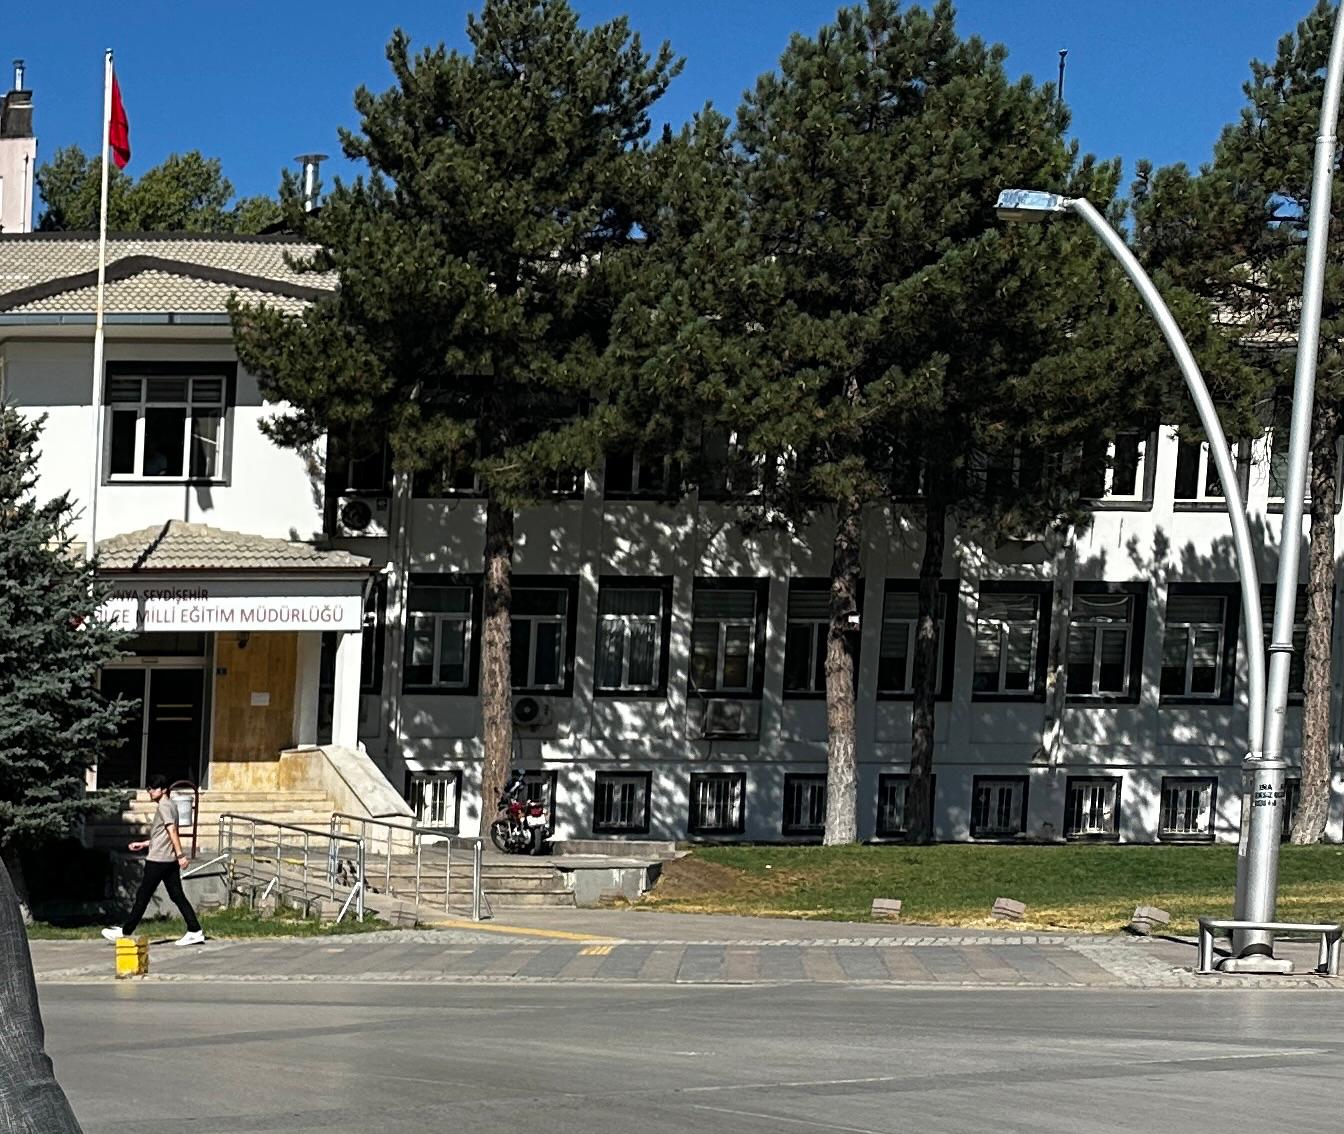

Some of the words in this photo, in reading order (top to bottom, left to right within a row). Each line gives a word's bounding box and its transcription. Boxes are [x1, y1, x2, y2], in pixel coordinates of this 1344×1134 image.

[143, 586, 209, 604] SEYDİŞEHİR
[136, 607, 176, 623] MİLLİ
[181, 606, 234, 623] EĞİTİM
[240, 604, 344, 623] MÜDÜRLÜĞÜ
